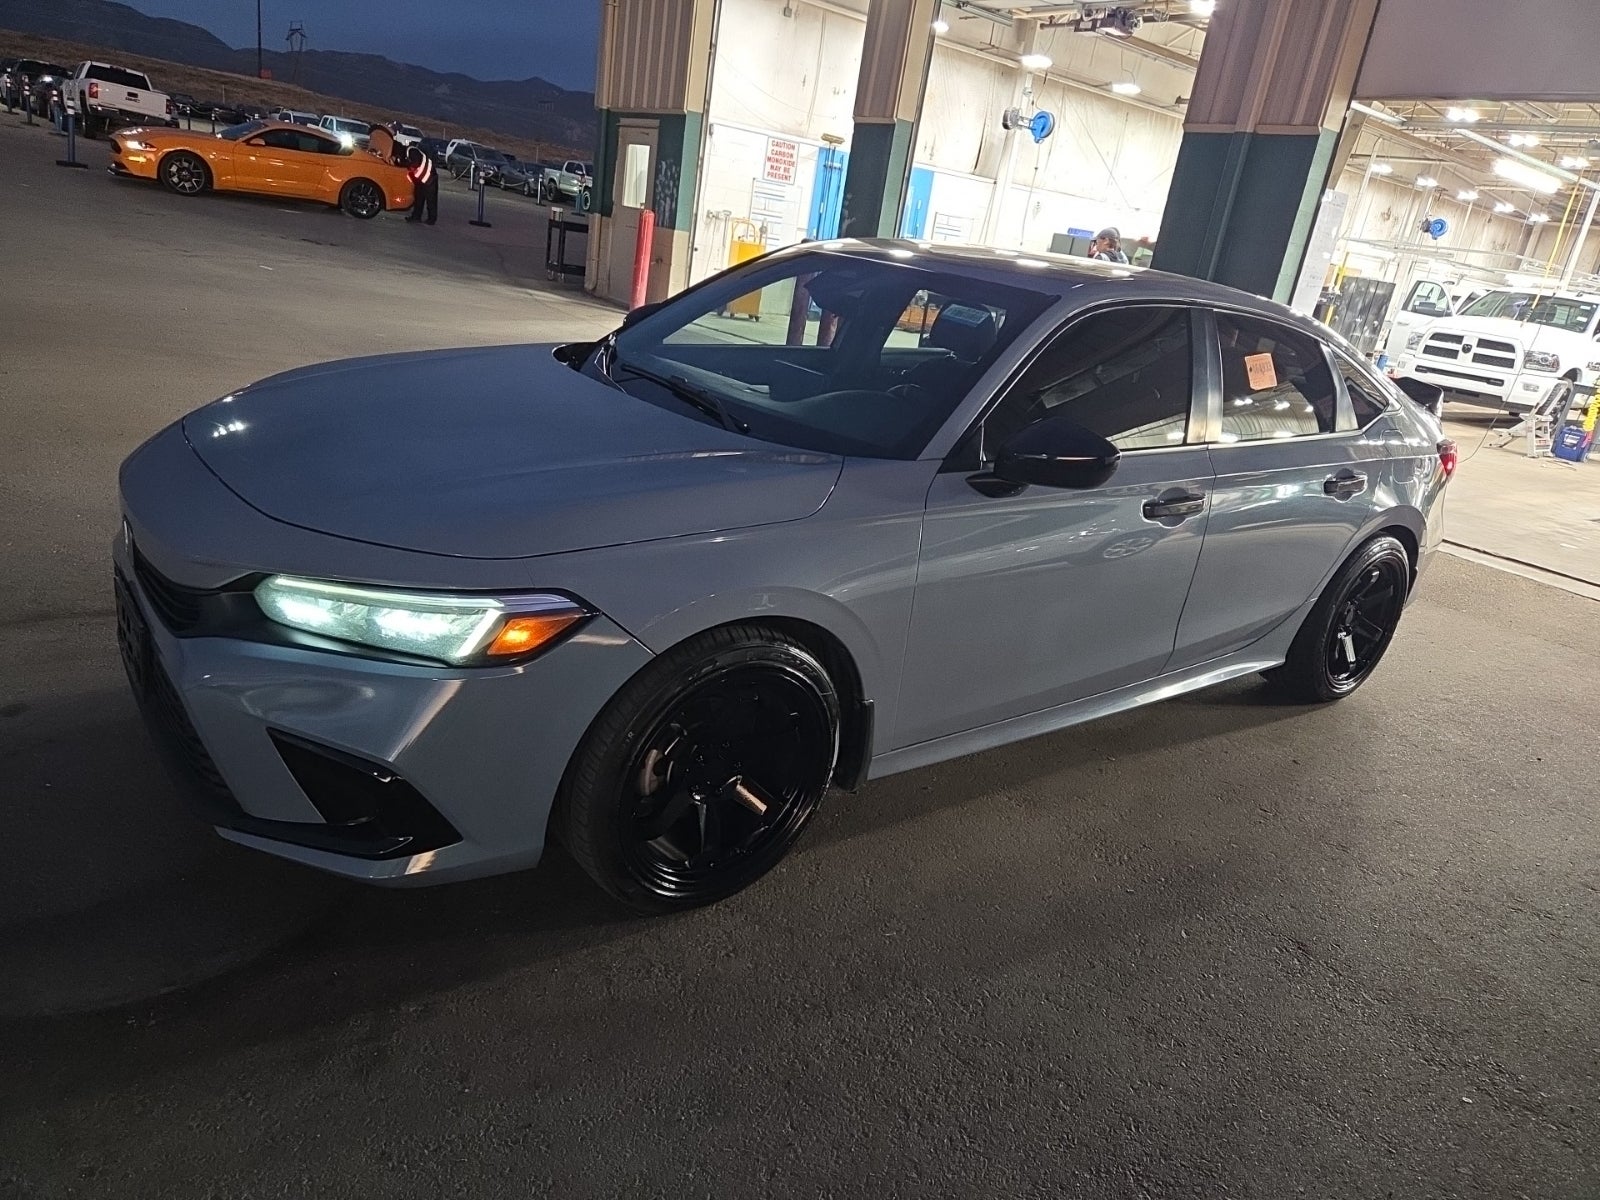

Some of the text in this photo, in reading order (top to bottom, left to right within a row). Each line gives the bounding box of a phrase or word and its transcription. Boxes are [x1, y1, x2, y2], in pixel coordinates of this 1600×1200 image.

[771, 140, 796, 150] CAUTION
[770, 149, 794, 159] CARBON
[767, 156, 796, 167] MONOXIDE
[770, 164, 781, 172] MAY
[767, 171, 791, 181] PRESENT
